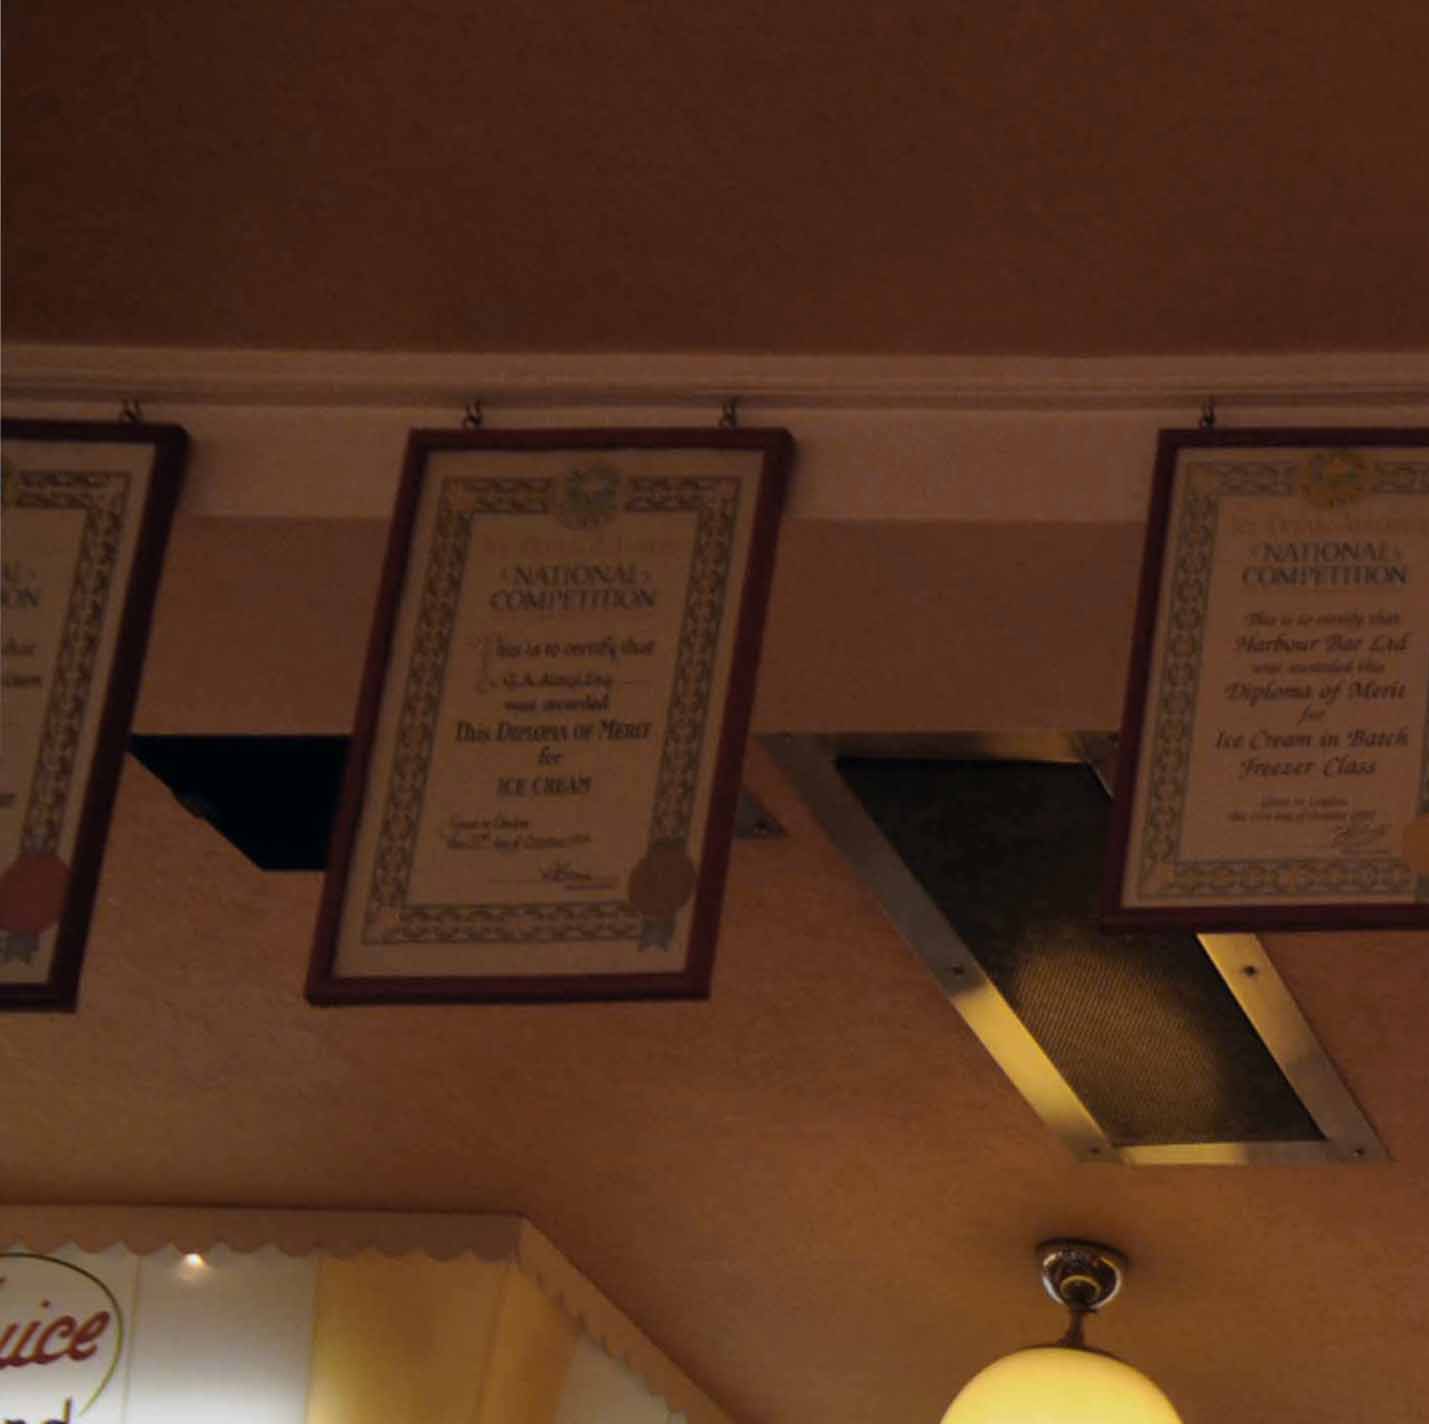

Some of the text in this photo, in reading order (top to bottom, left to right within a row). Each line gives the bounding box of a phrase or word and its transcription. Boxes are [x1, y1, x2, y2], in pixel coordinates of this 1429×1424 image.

[1263, 542, 1387, 562] NATIONAL
[512, 565, 639, 585] NATIONAL
[1242, 565, 1408, 585] COMPETITION
[489, 588, 656, 610] COMPETITION
[0, 1299, 109, 1368] uice
